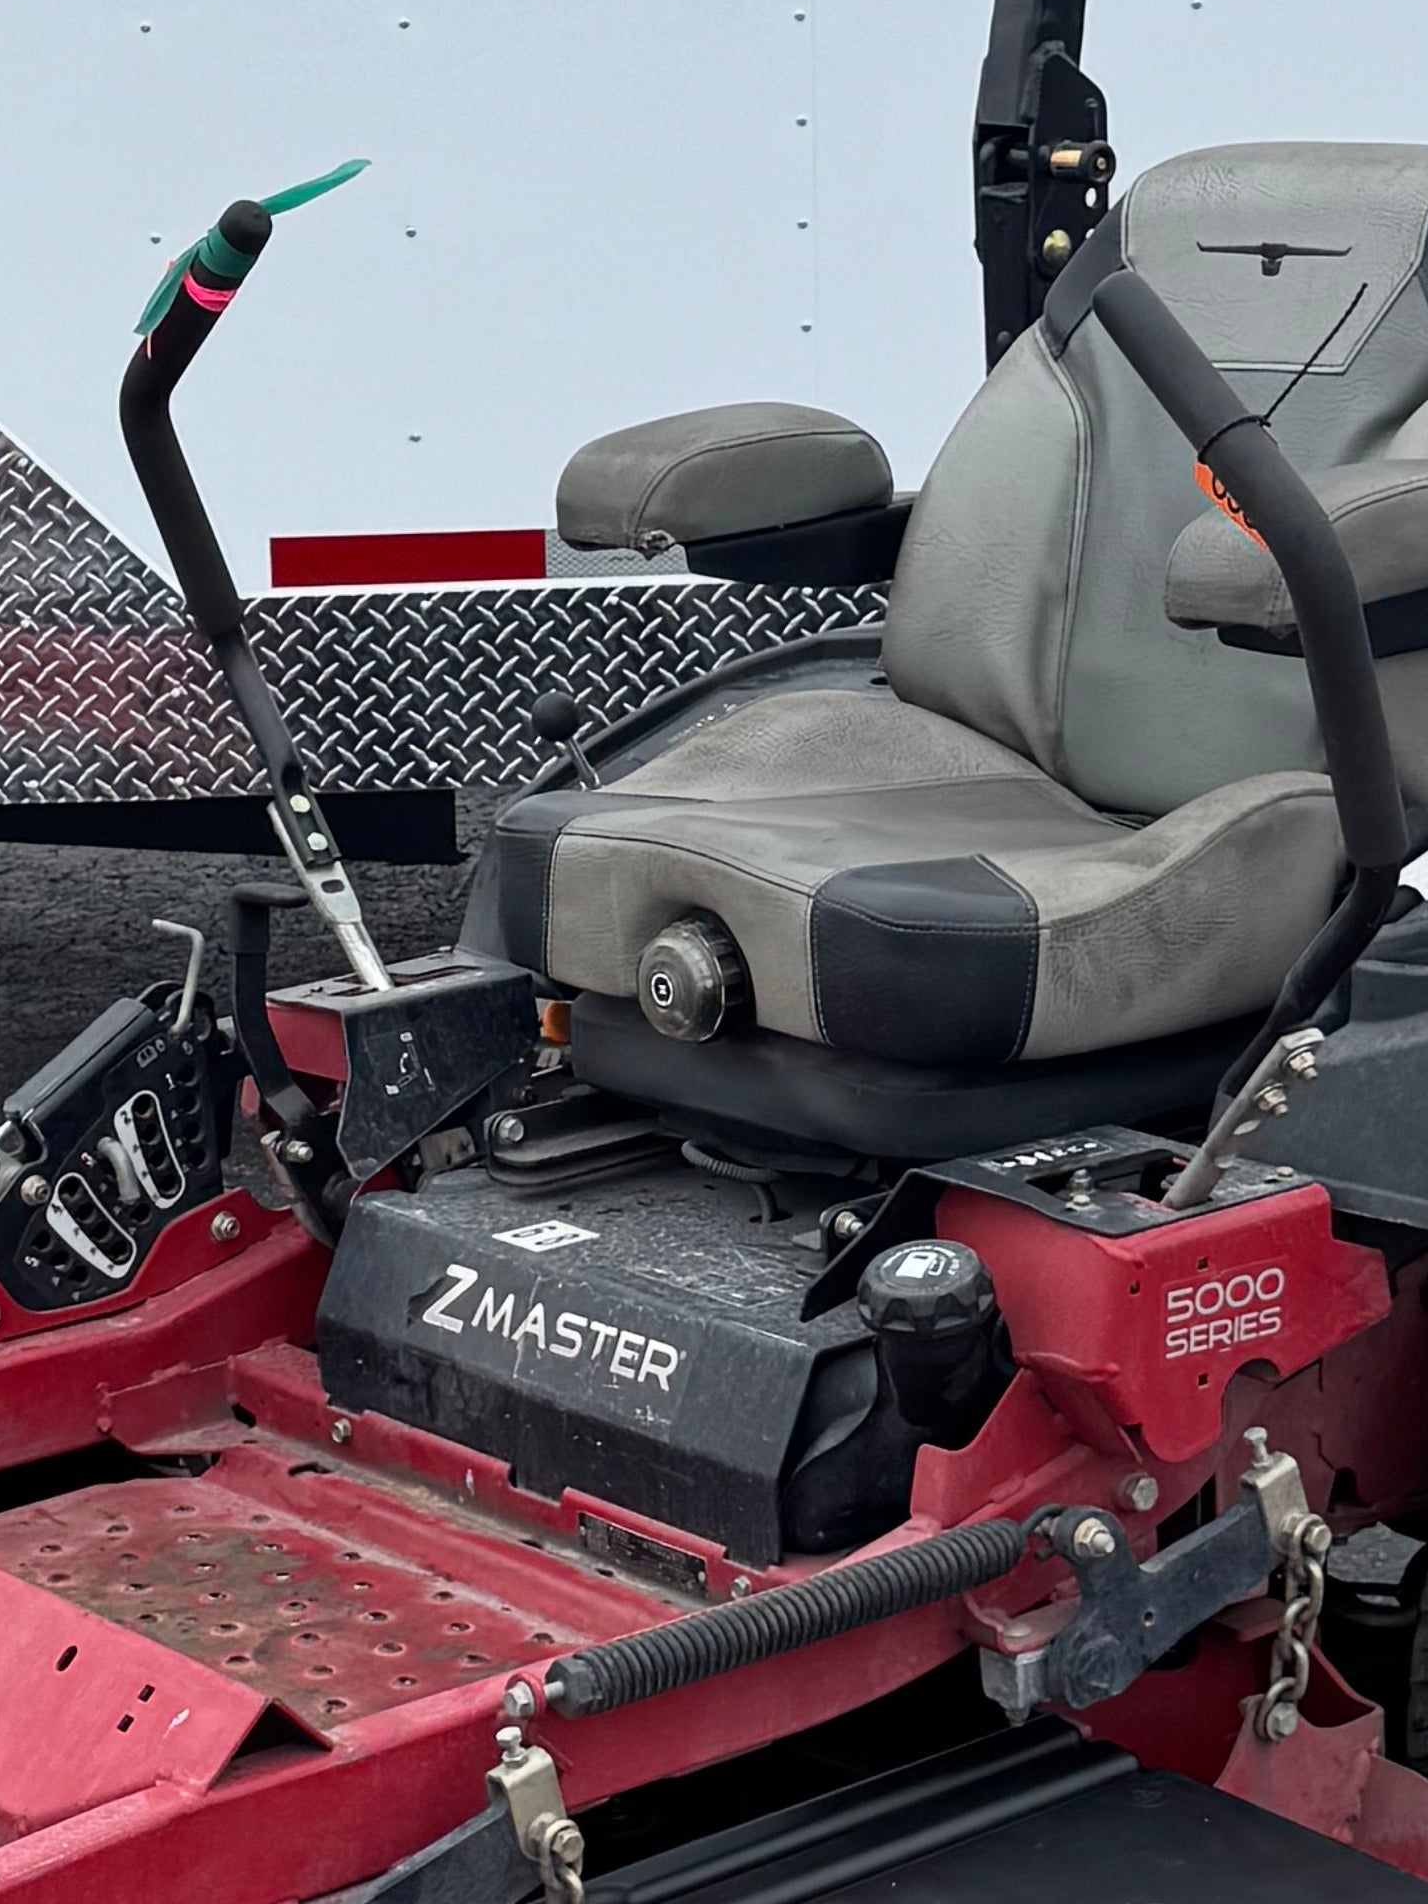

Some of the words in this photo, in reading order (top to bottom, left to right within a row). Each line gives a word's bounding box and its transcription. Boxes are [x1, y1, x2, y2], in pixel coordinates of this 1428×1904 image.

[1166, 1267, 1285, 1324] 5000
[471, 1286, 679, 1392] MASTER
[1165, 1306, 1282, 1359] SERIES
